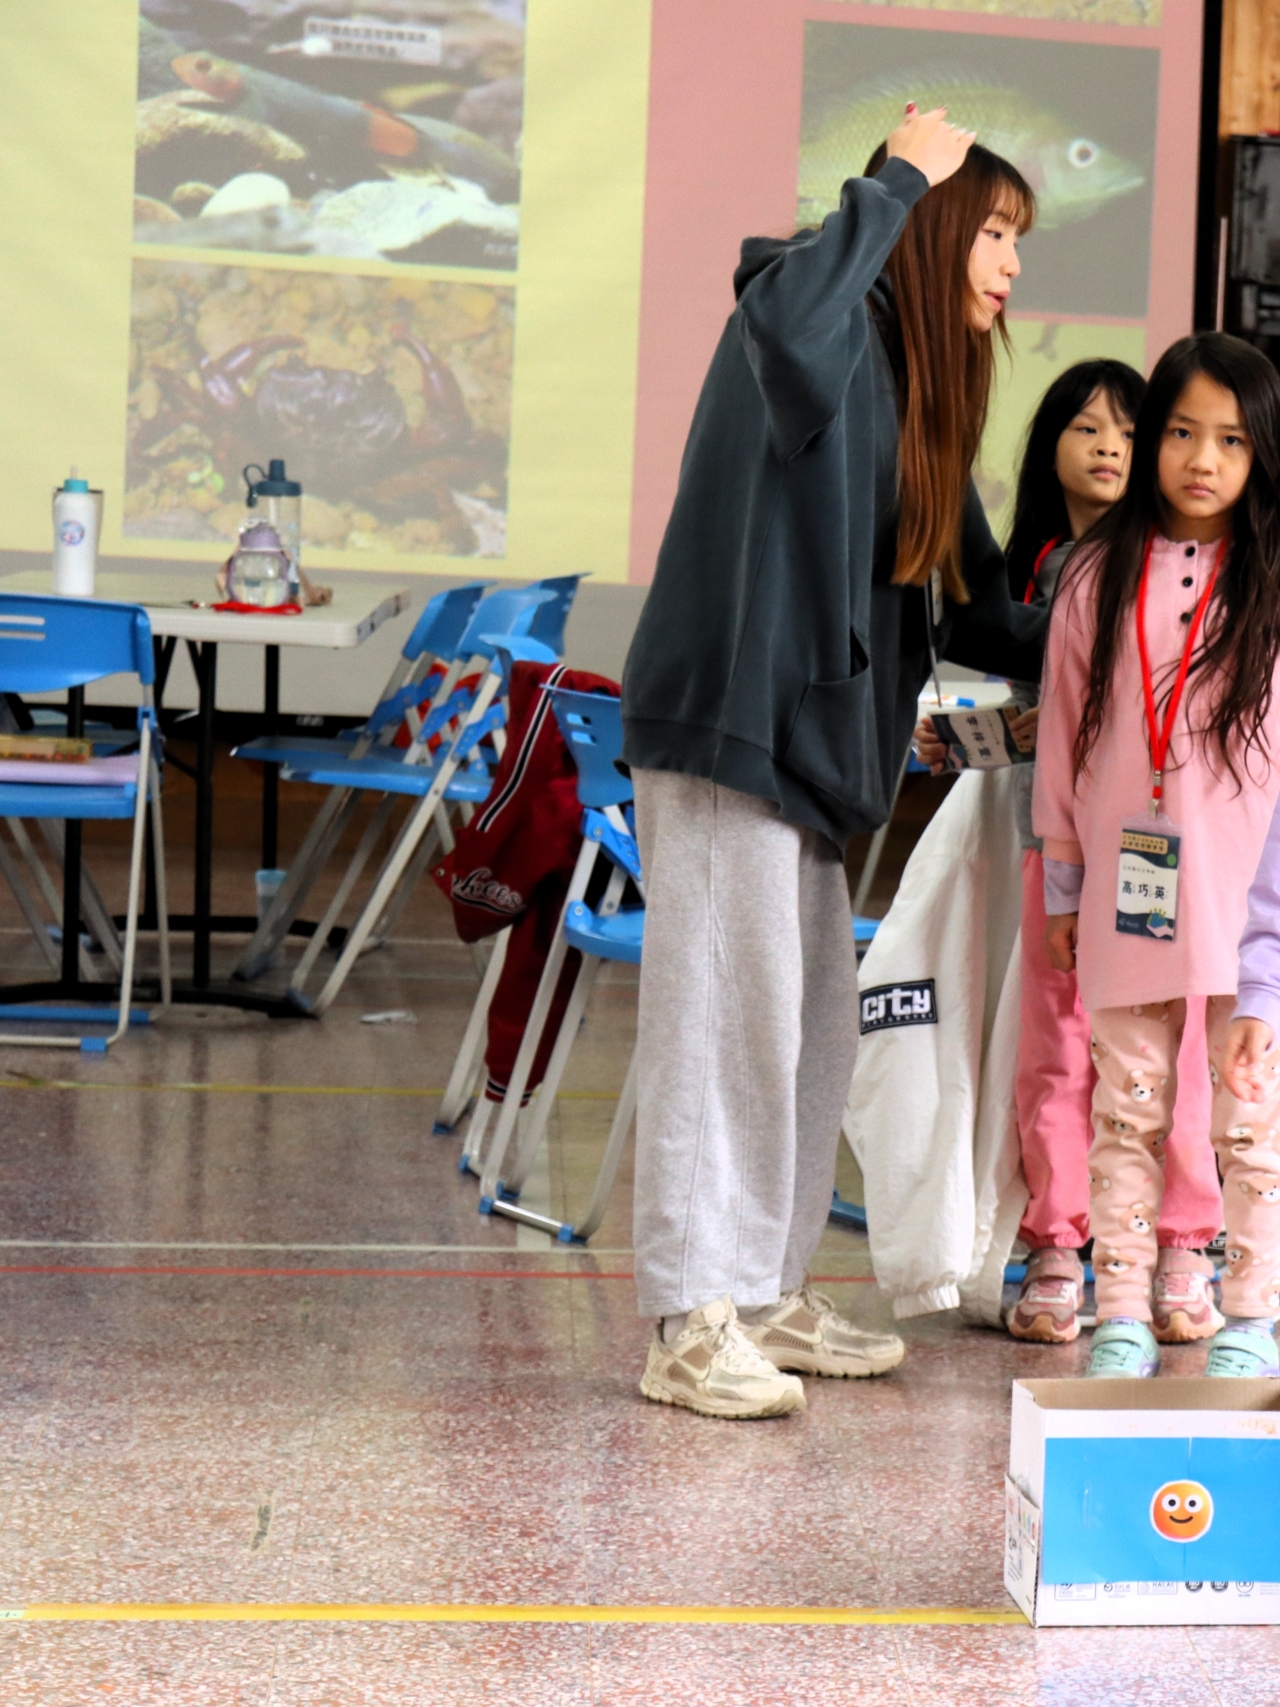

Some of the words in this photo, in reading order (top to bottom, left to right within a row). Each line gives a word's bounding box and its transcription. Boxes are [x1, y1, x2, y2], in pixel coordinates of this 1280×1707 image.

[1122, 880, 1166, 900] 高巧英
[862, 1013, 932, 1027] PLAYGROUND
